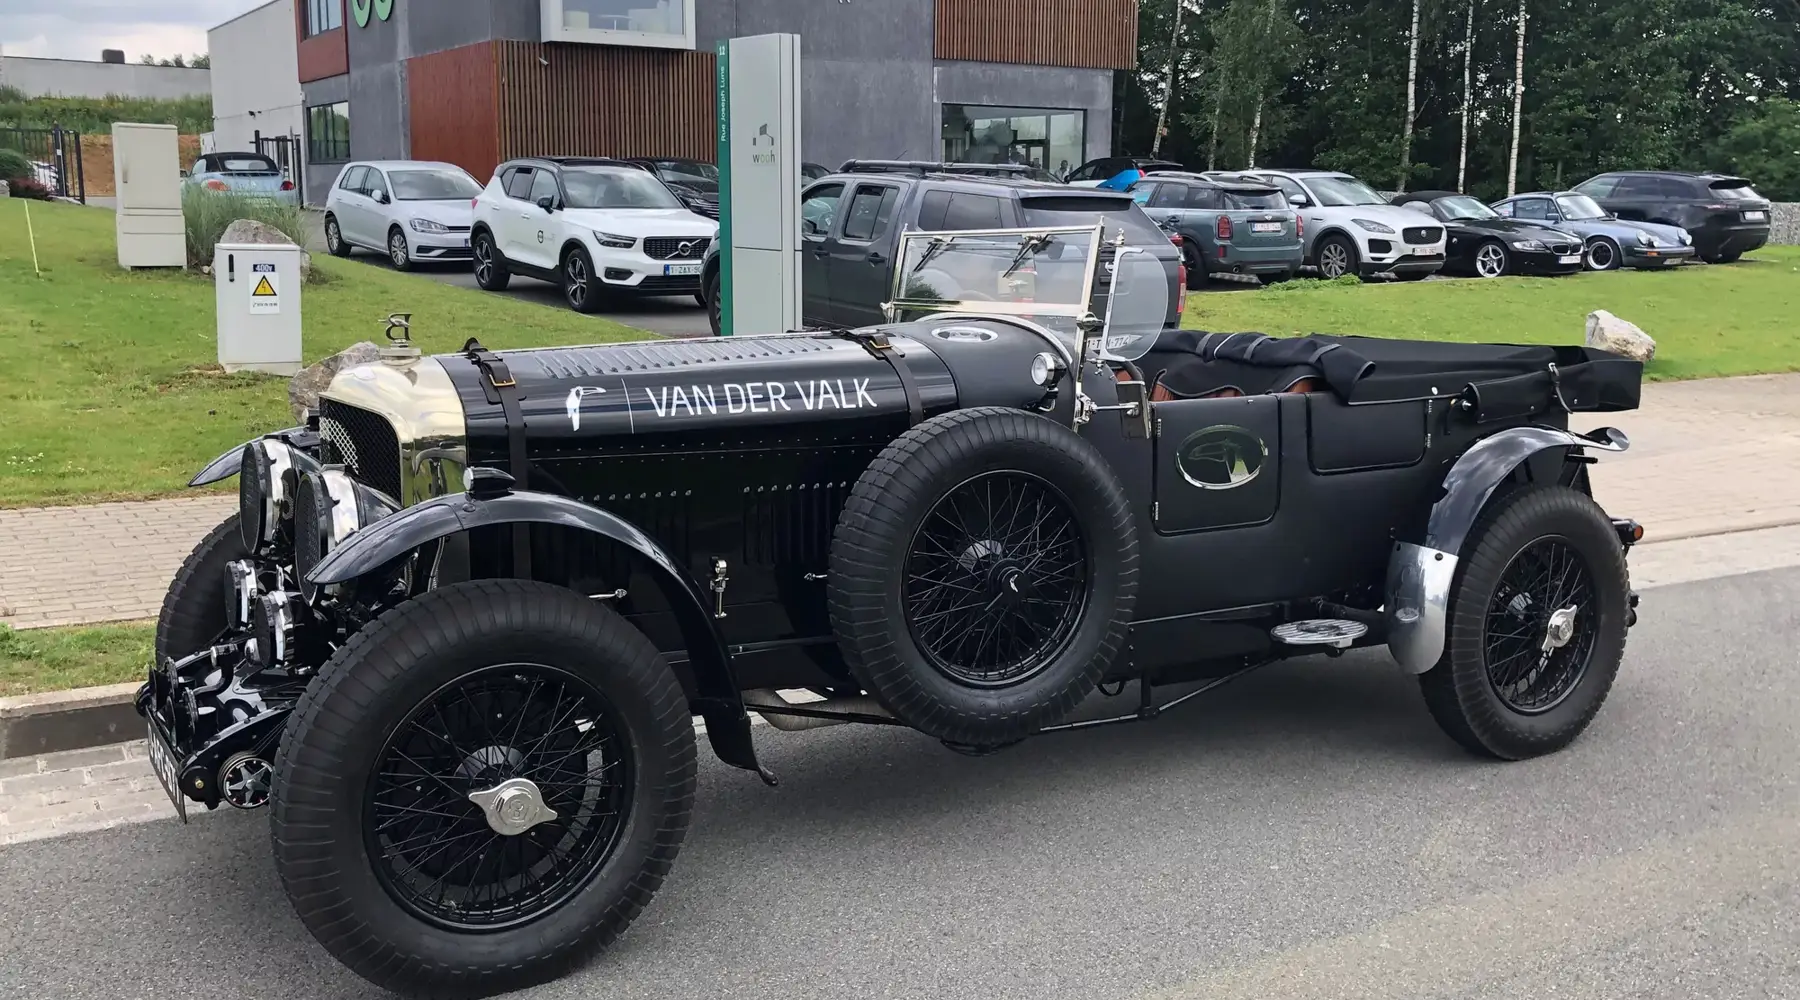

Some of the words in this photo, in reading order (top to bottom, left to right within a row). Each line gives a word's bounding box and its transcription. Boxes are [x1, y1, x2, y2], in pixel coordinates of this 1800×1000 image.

[719, 45, 726, 56] 12
[752, 149, 776, 164] wooh
[645, 384, 718, 417] VAN
[723, 380, 791, 414] DER
[794, 377, 878, 410] VALK
